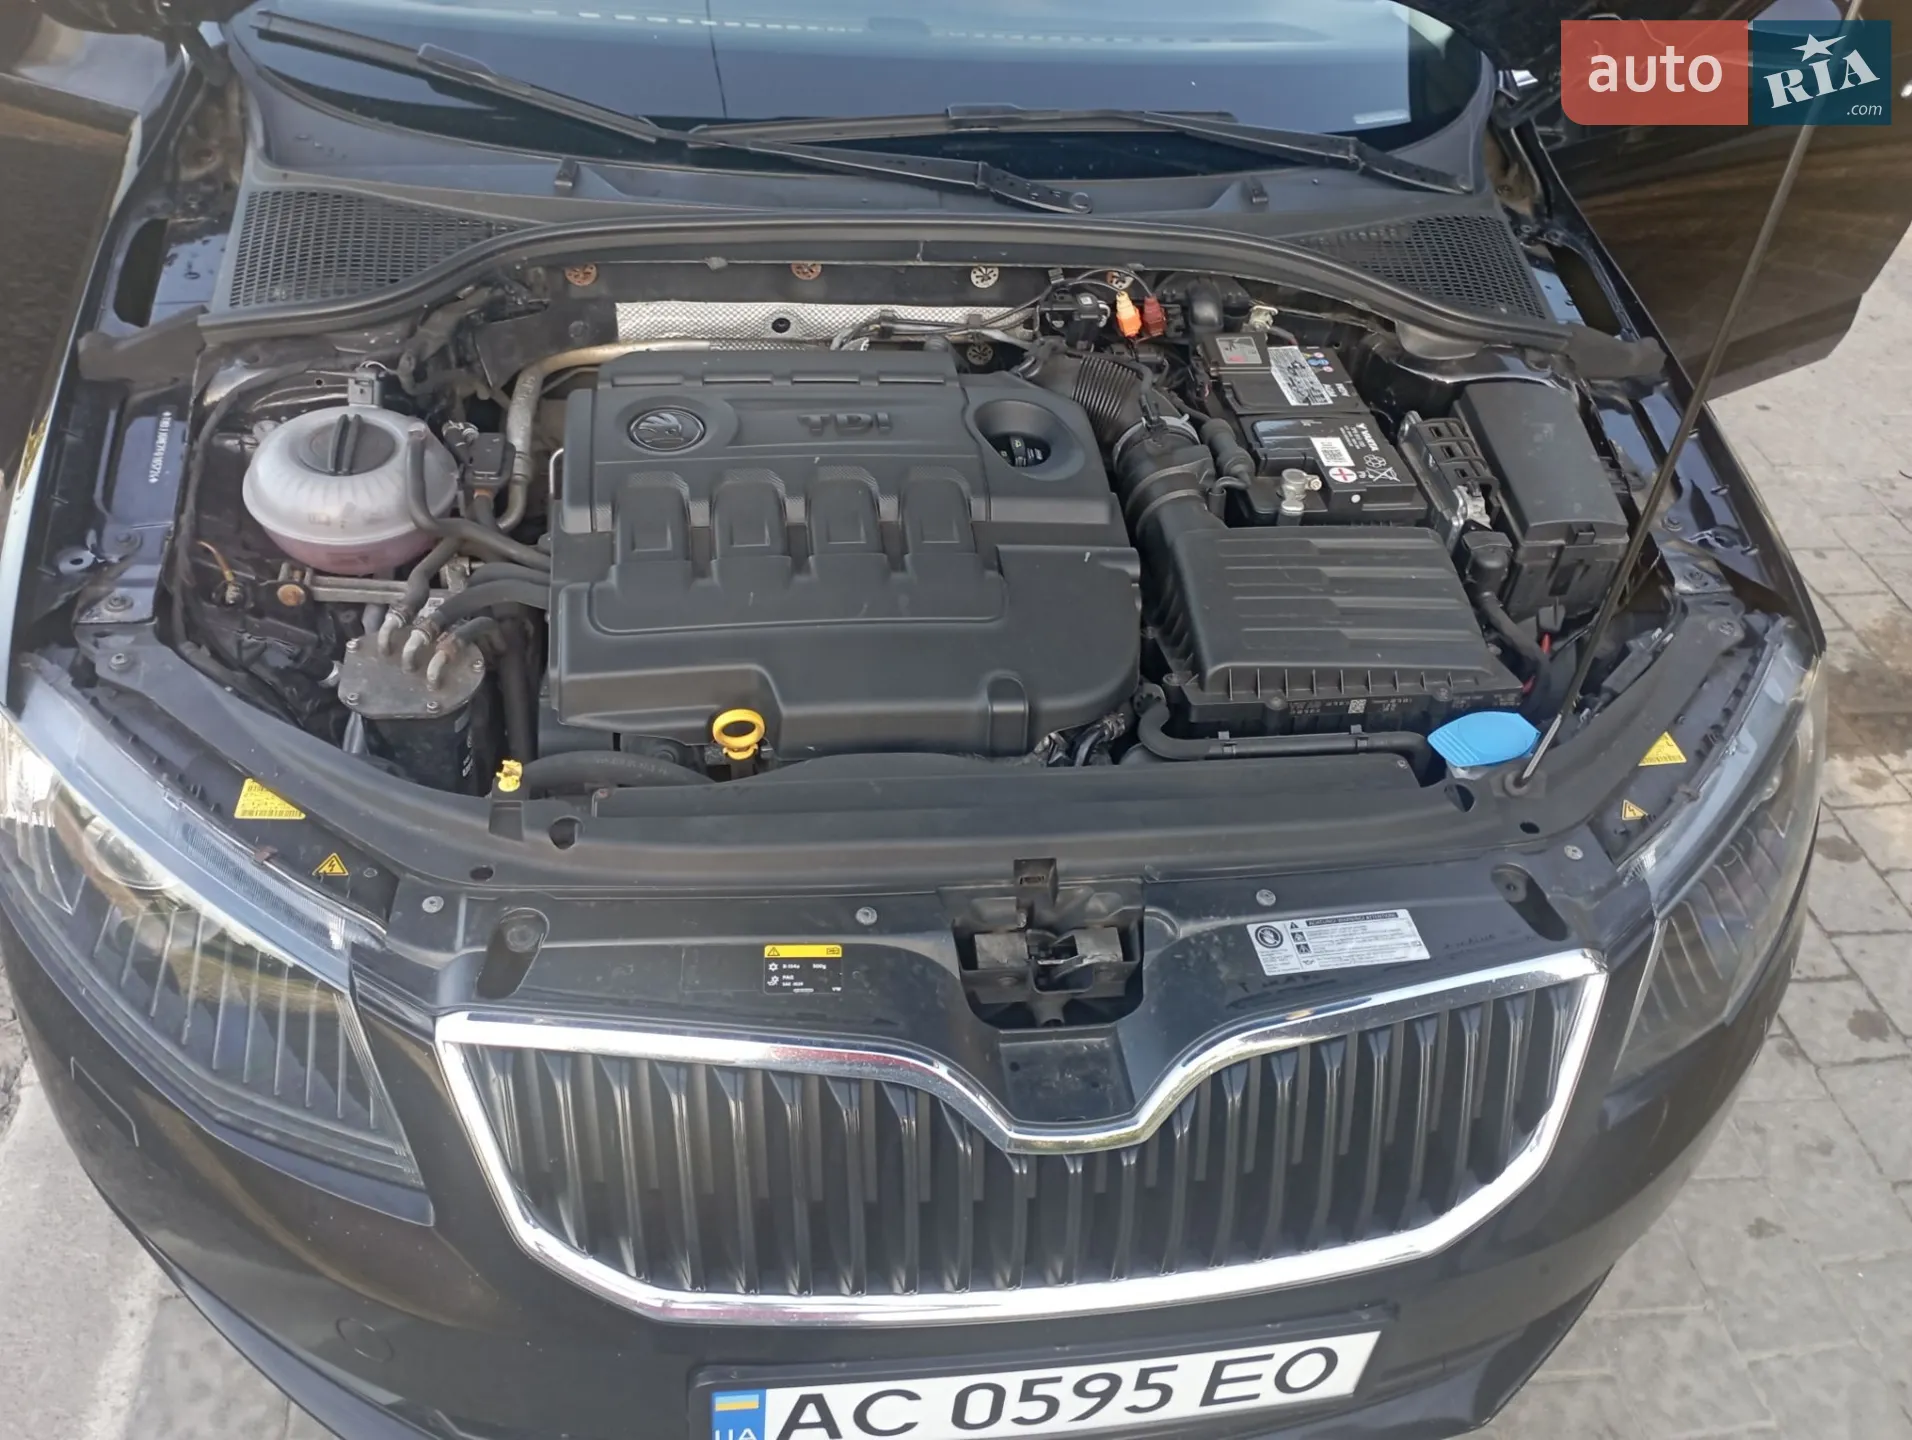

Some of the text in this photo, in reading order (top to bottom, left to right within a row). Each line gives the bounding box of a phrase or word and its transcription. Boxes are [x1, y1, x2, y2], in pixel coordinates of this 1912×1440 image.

[798, 412, 893, 436] TDI
[776, 1346, 1339, 1440] AC 0595 EO
